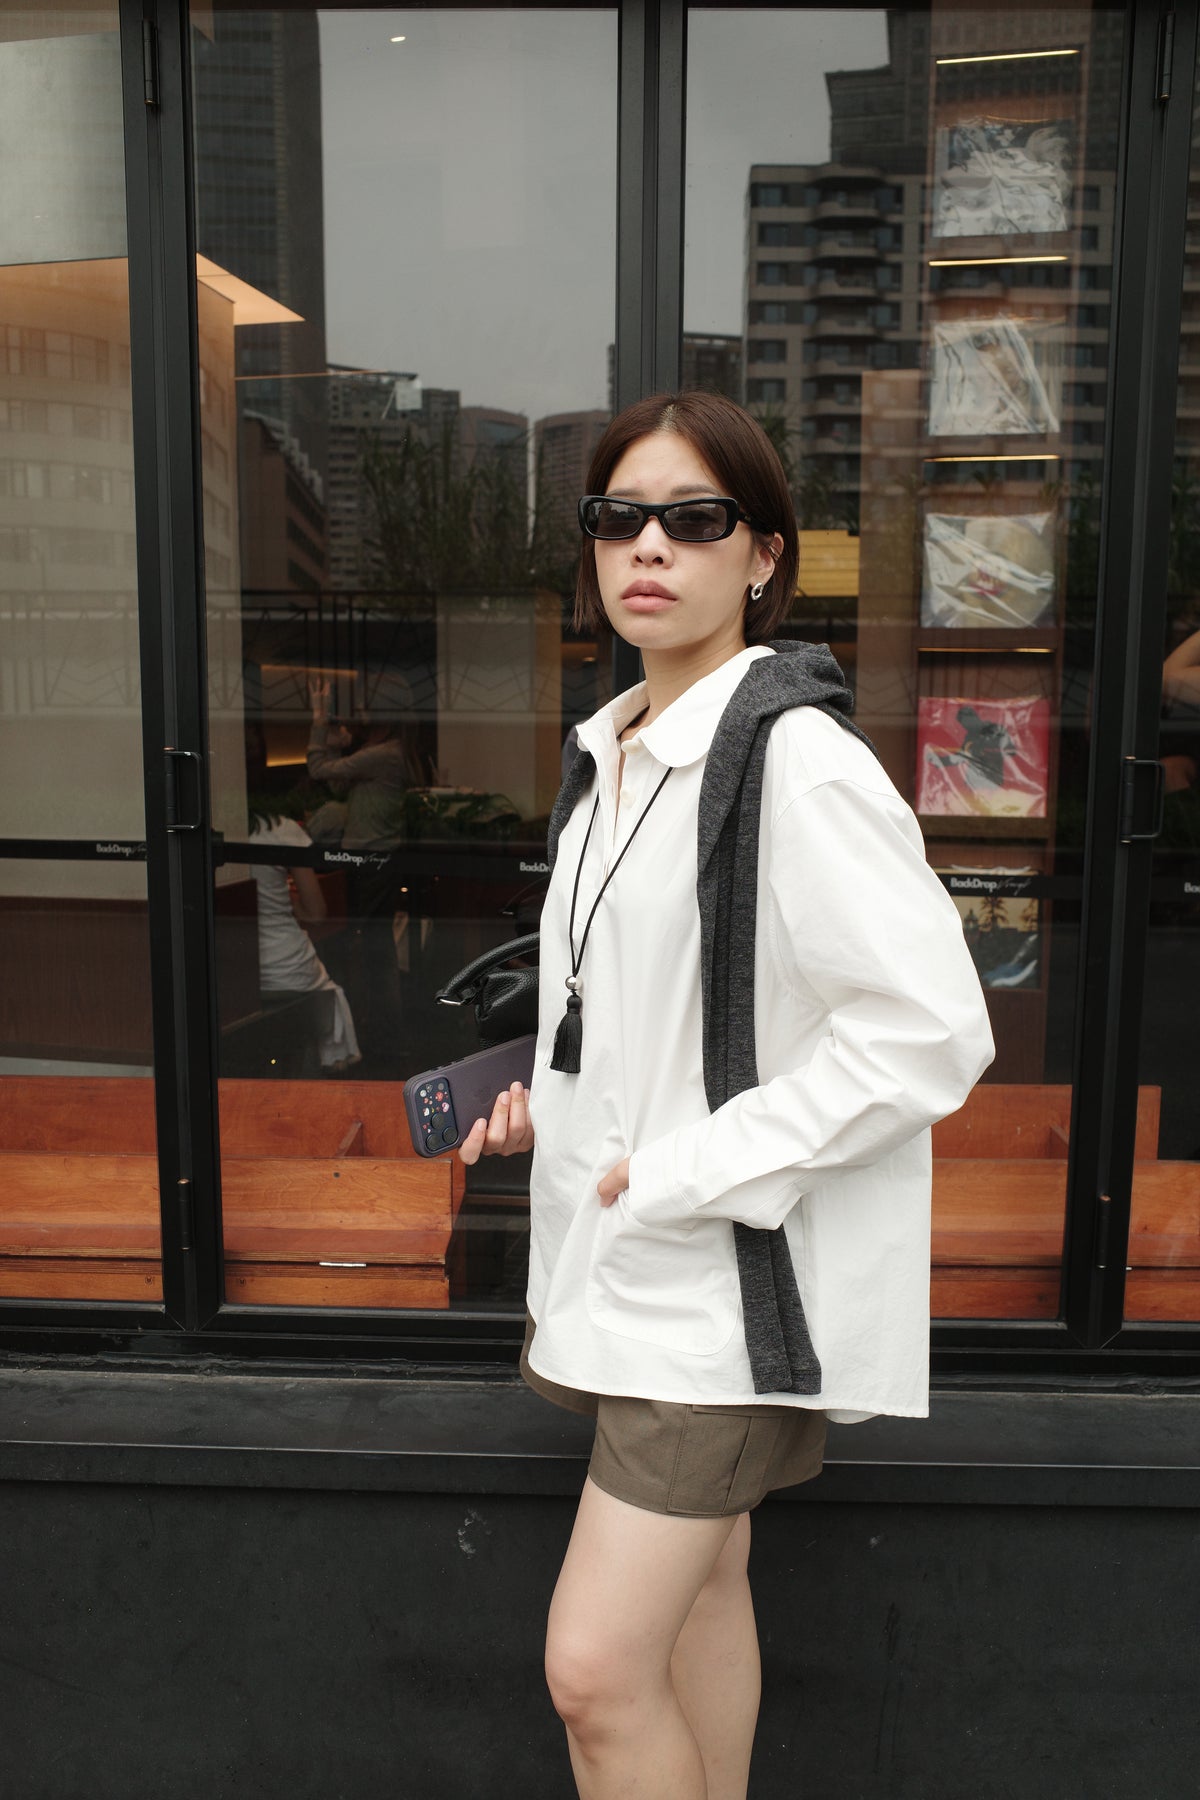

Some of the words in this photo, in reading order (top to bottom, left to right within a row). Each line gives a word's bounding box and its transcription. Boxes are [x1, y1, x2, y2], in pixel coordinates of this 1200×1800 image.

[324, 851, 364, 867] BackDrop
[519, 861, 550, 872] BackDr
[950, 877, 998, 893] BackDrop
